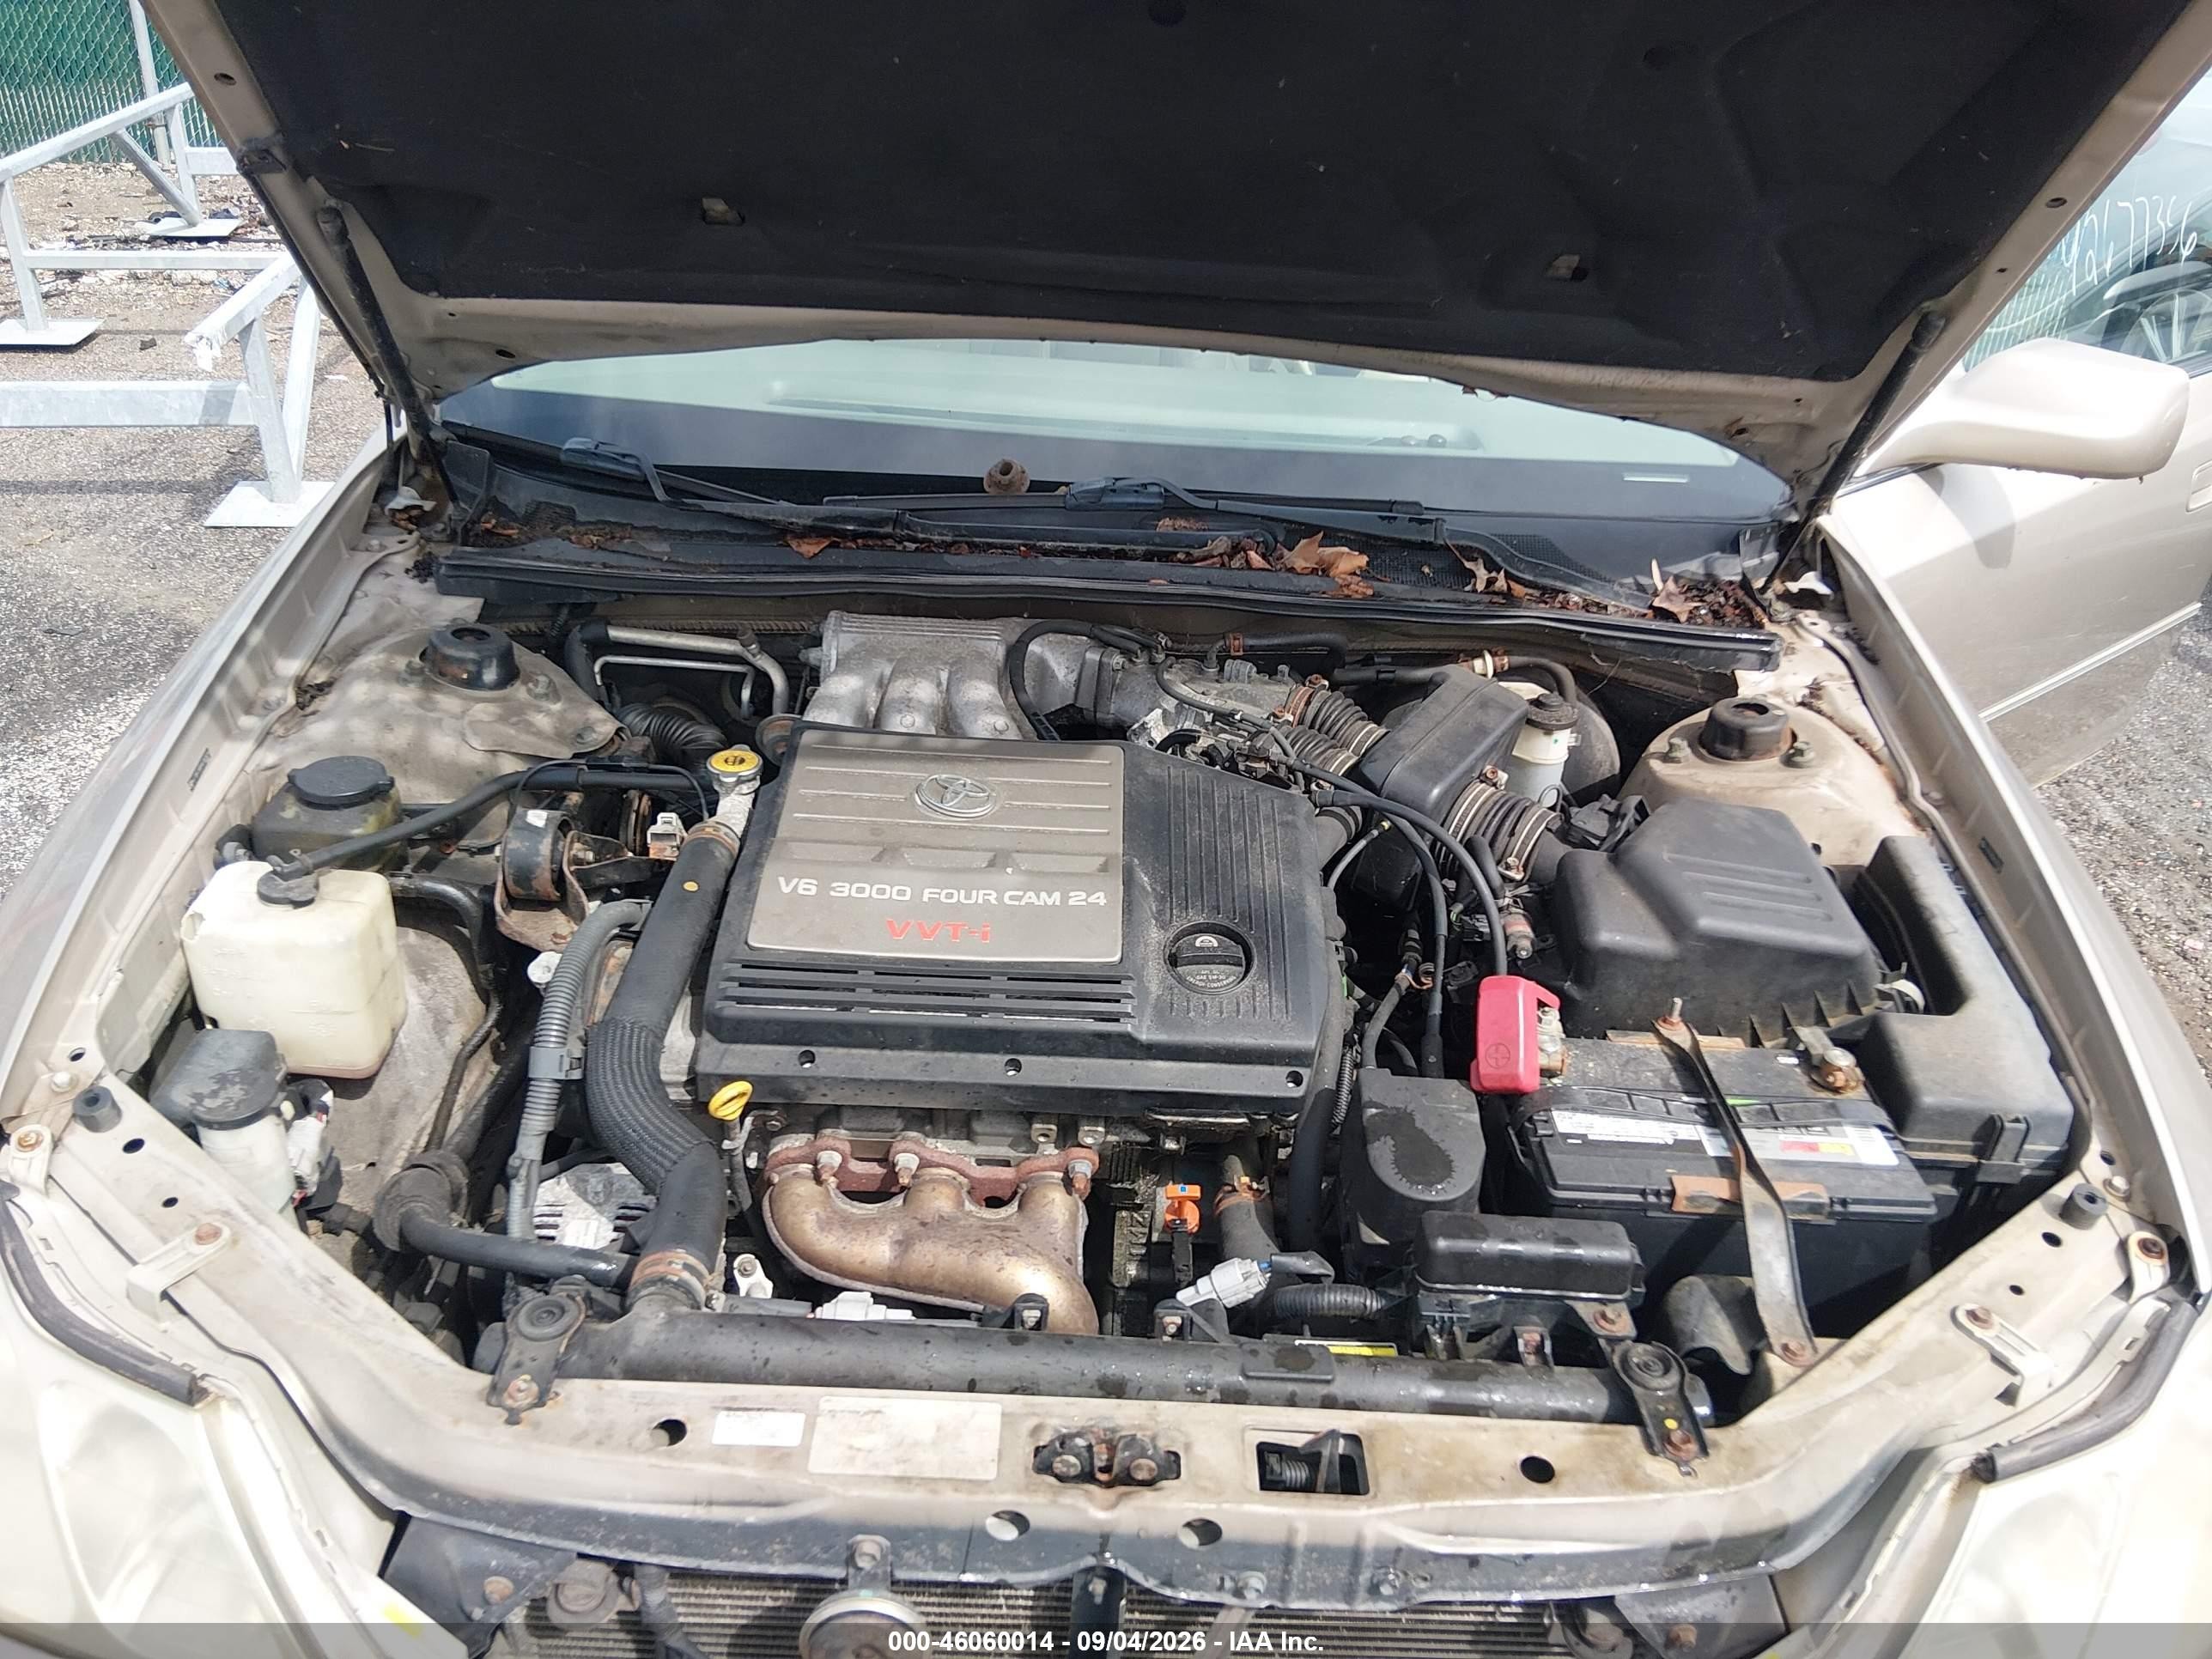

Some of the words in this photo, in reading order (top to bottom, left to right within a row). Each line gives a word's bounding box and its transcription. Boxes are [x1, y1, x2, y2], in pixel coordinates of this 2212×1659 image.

[777, 876, 817, 896] V6
[830, 882, 912, 902] 3000
[922, 887, 999, 905] FOUR
[1003, 890, 1061, 907] CAM
[1068, 890, 1108, 907] 24
[885, 919, 991, 943] VVT-i
